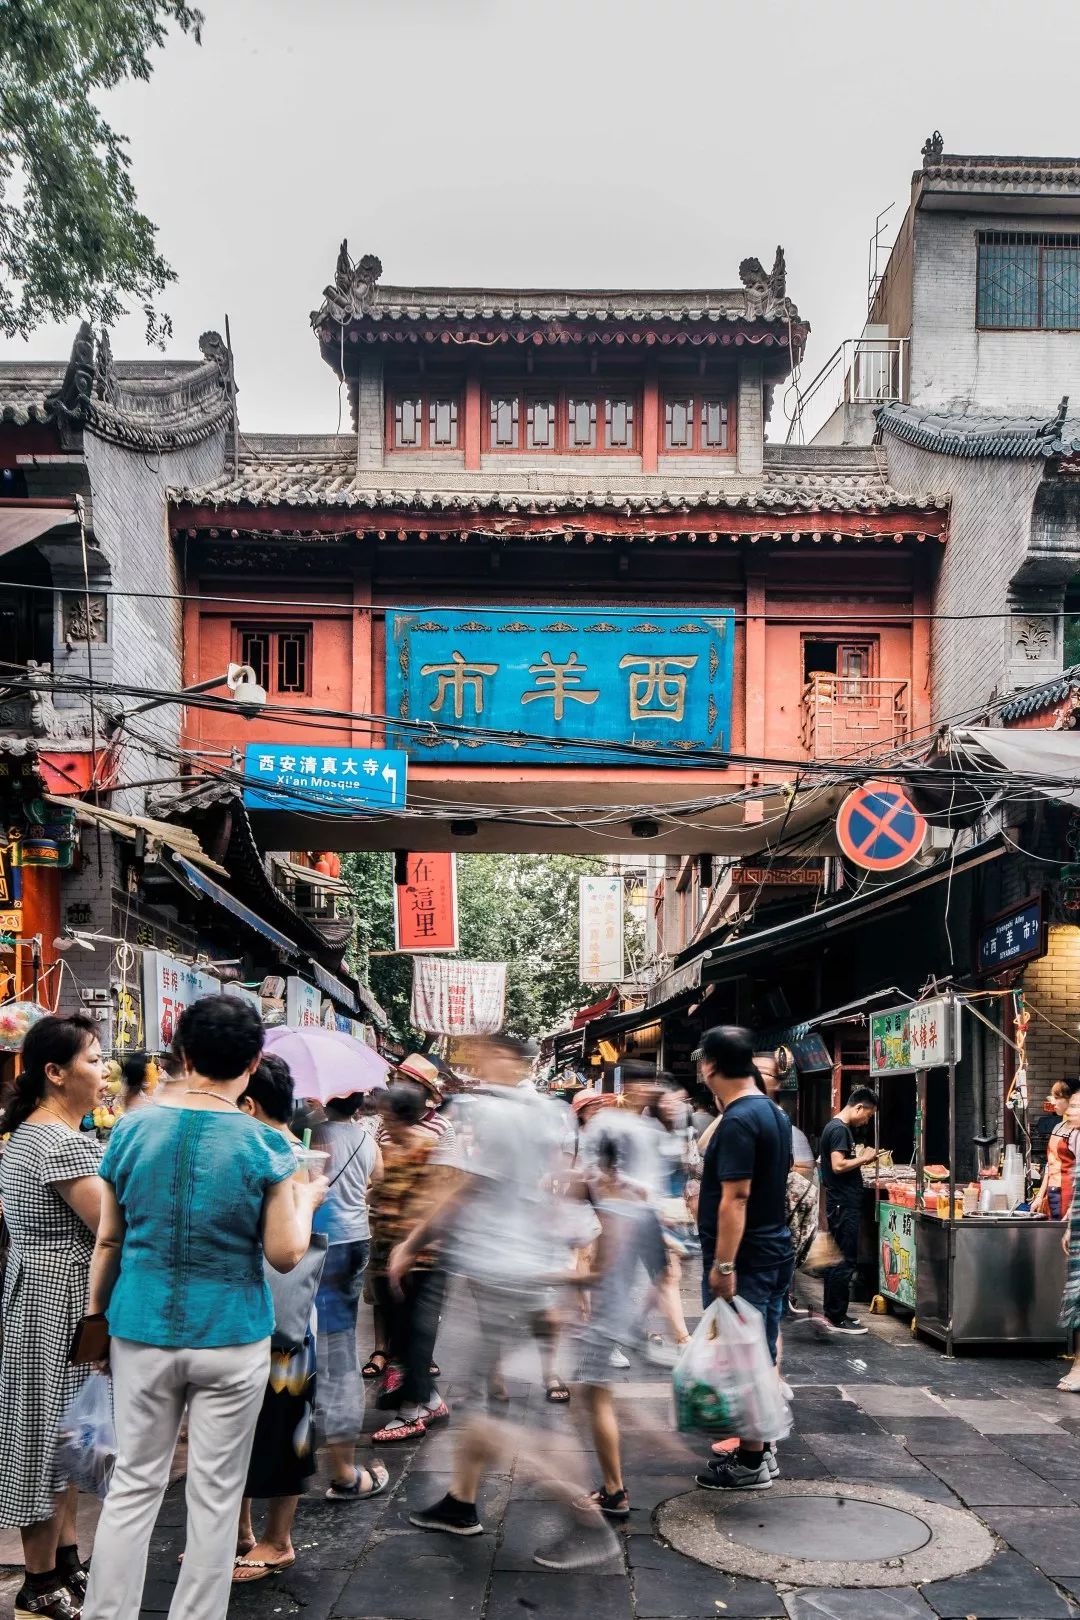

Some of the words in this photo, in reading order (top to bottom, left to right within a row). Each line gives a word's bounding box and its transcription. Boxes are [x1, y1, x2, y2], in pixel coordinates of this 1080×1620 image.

[258, 755, 380, 777] 西安清真大寺
[277, 775, 308, 787] Xi'an
[311, 777, 361, 790] Mosque
[990, 921, 1031, 955] 西羊市
